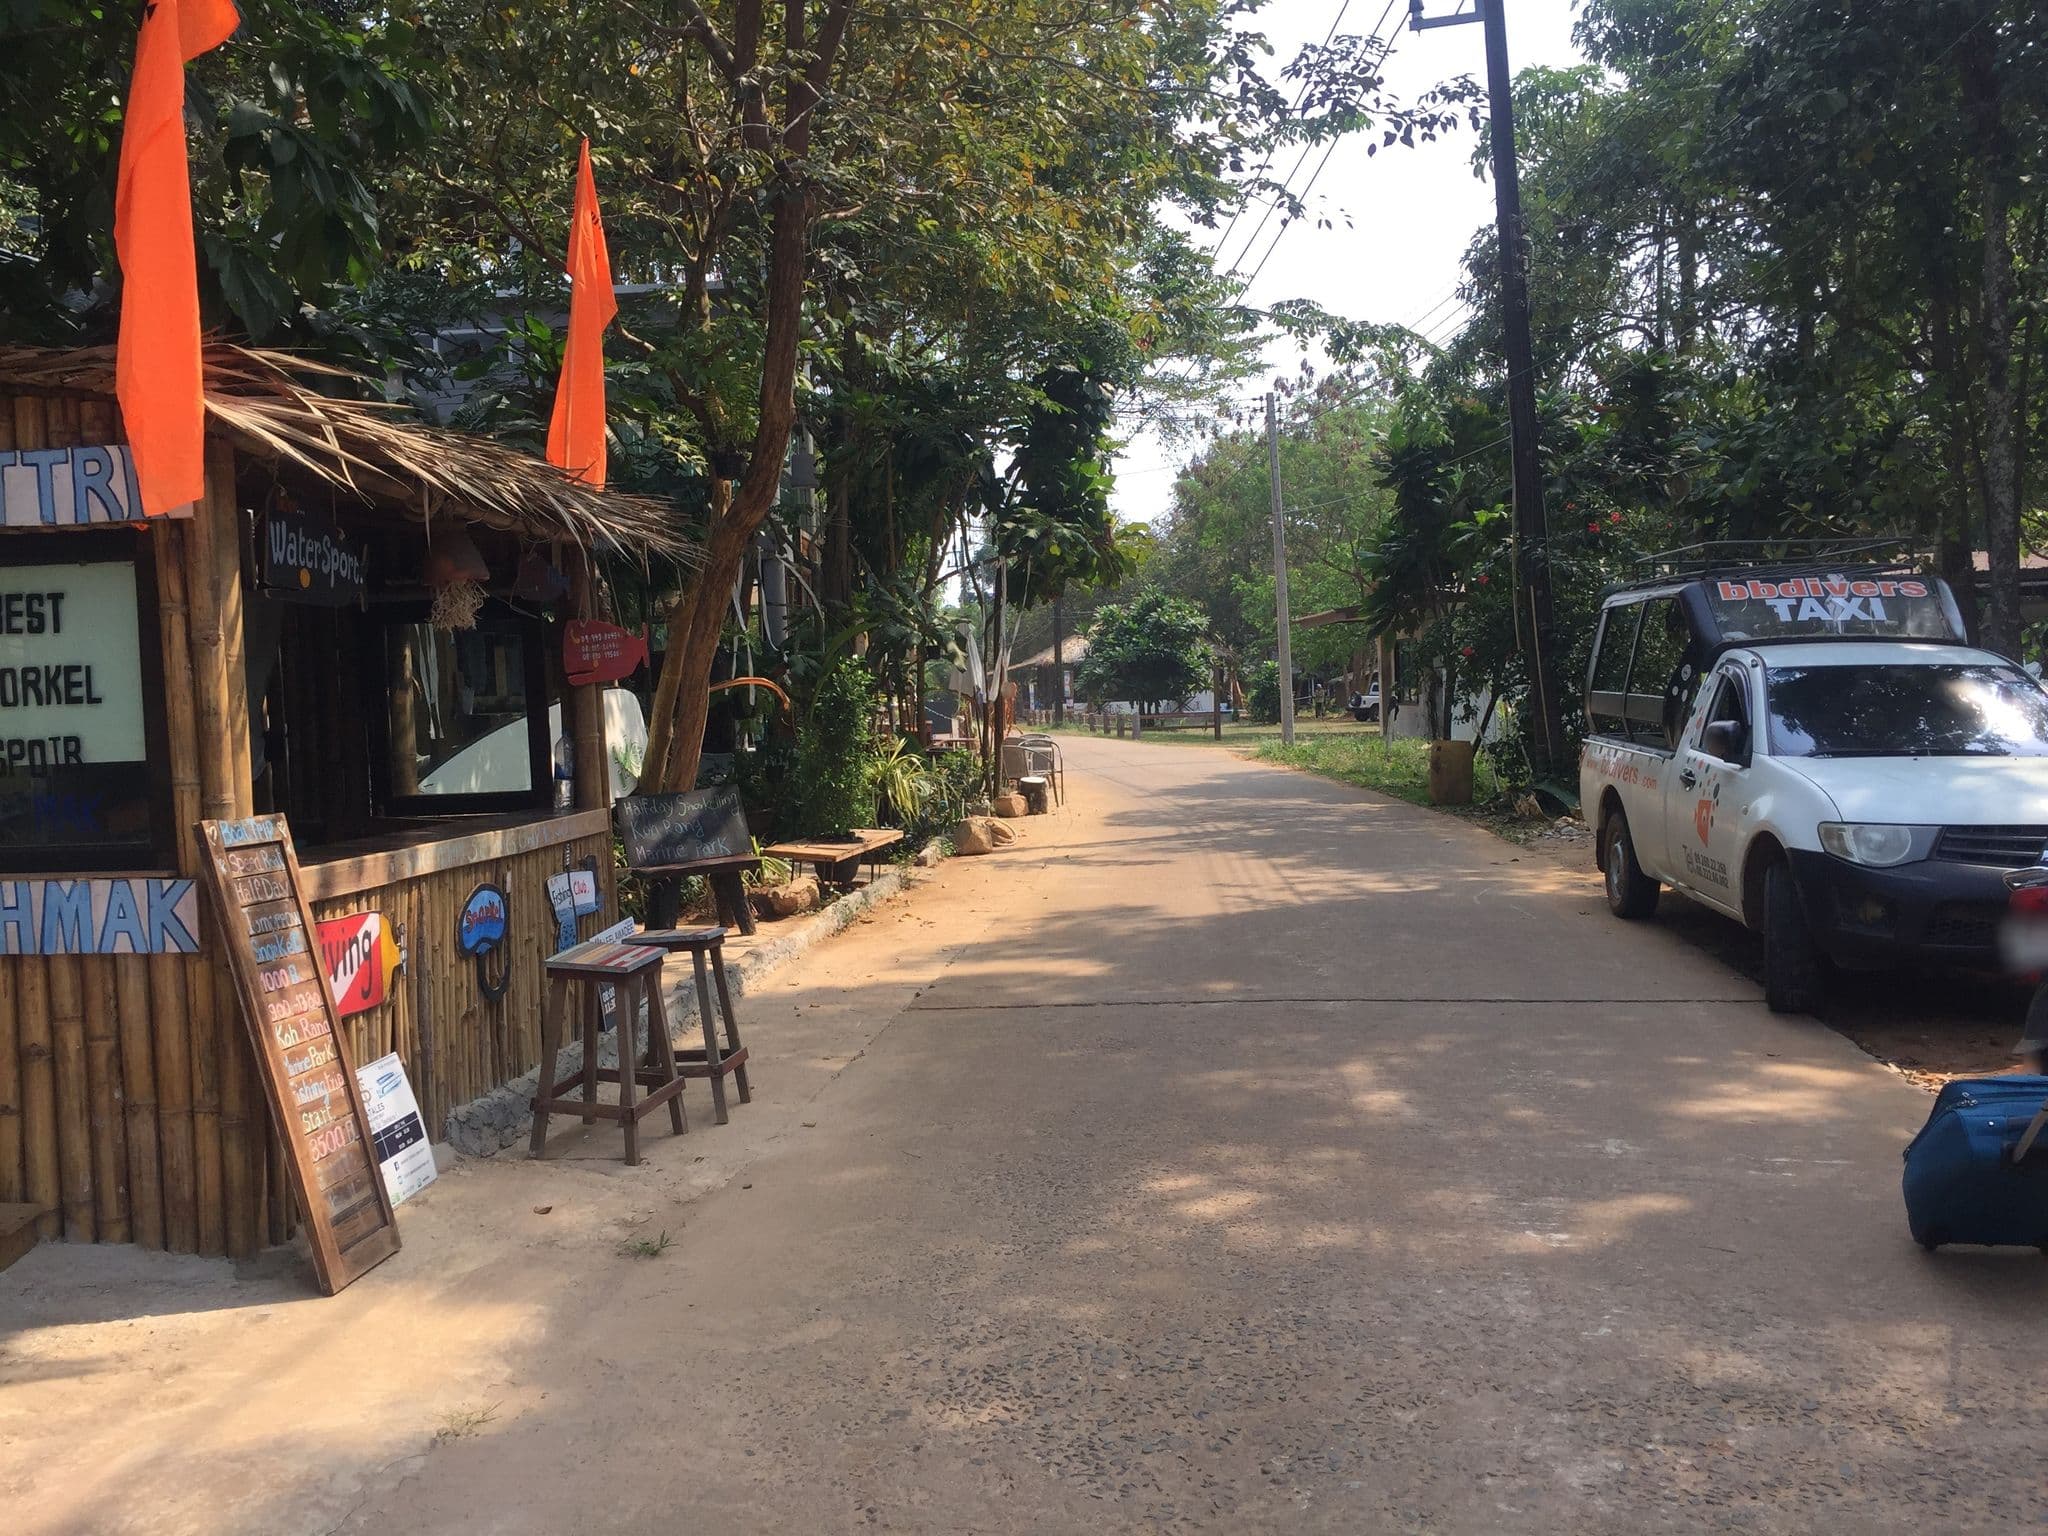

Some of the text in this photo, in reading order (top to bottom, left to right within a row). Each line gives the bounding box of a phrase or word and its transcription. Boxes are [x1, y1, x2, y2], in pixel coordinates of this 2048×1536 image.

[0, 446, 169, 526] TRI
[1716, 577, 1928, 602] bbdivers
[0, 592, 65, 634] EST
[1765, 597, 1888, 623] TAXI
[274, 1023, 298, 1047] Koh
